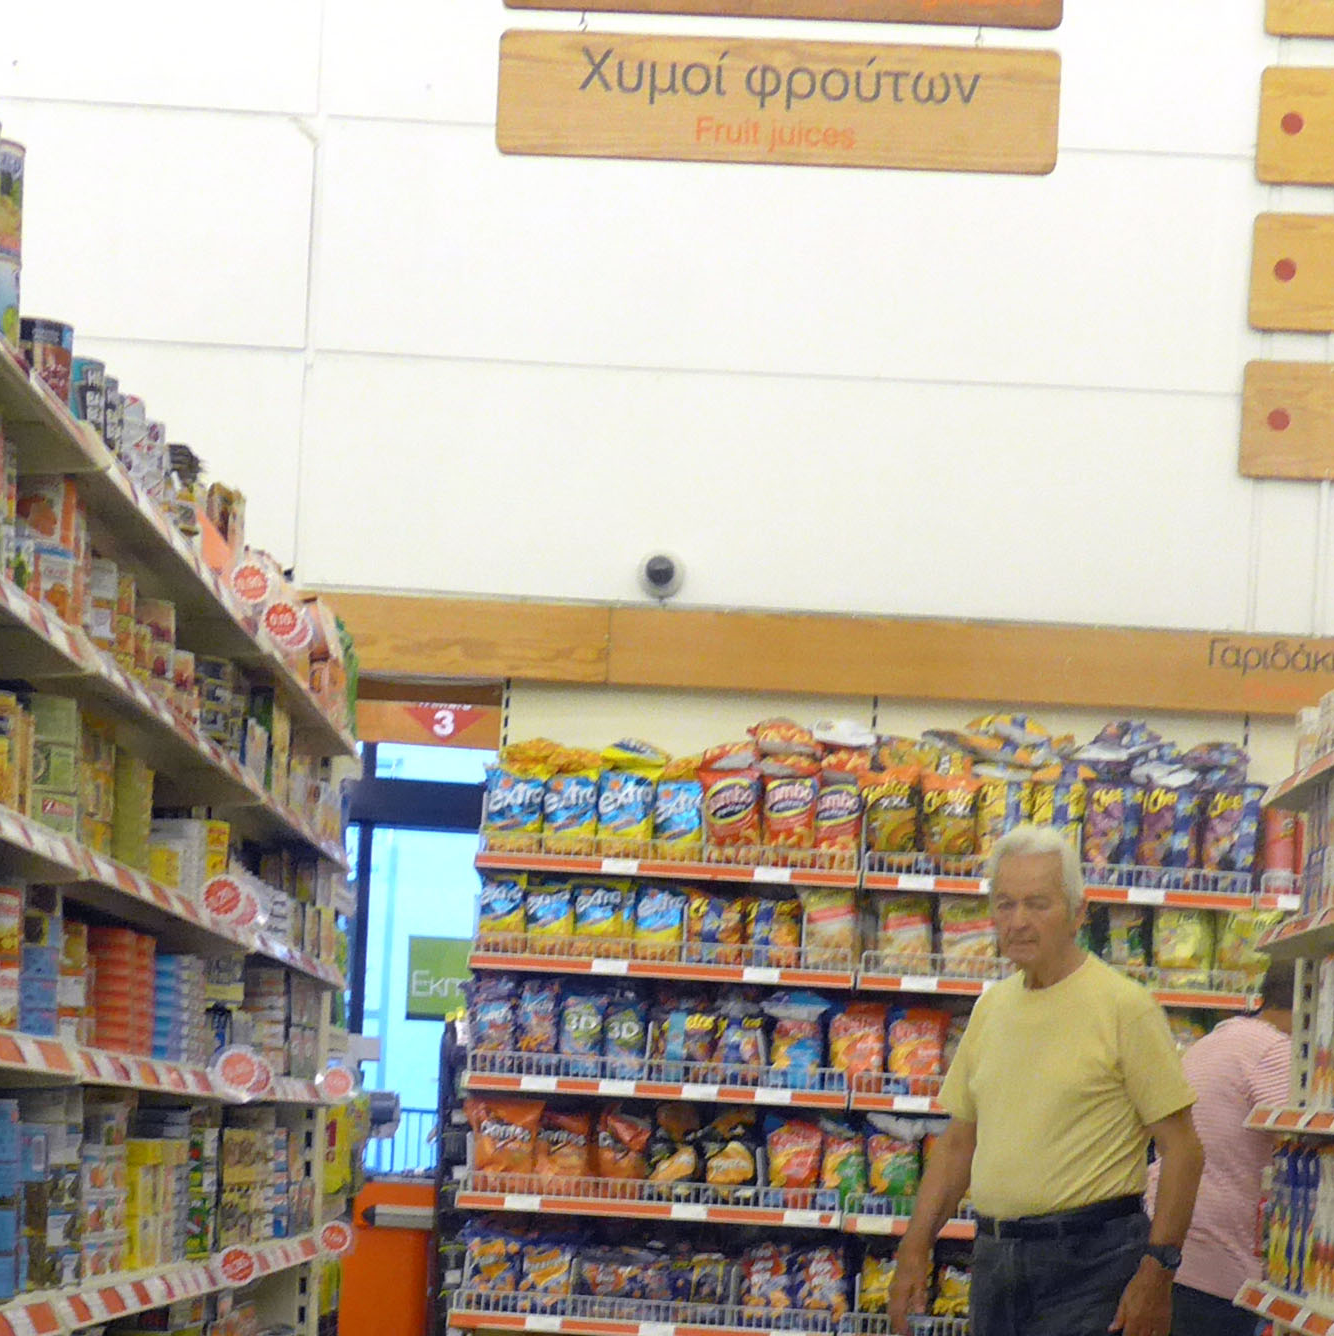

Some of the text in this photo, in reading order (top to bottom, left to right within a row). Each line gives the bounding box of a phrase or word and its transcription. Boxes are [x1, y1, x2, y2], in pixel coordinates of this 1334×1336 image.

[578, 47, 980, 110] Χυμοί φρούτων
[695, 116, 856, 153] Fruit juices
[433, 709, 455, 738] 3
[609, 1021, 639, 1046] 3D
